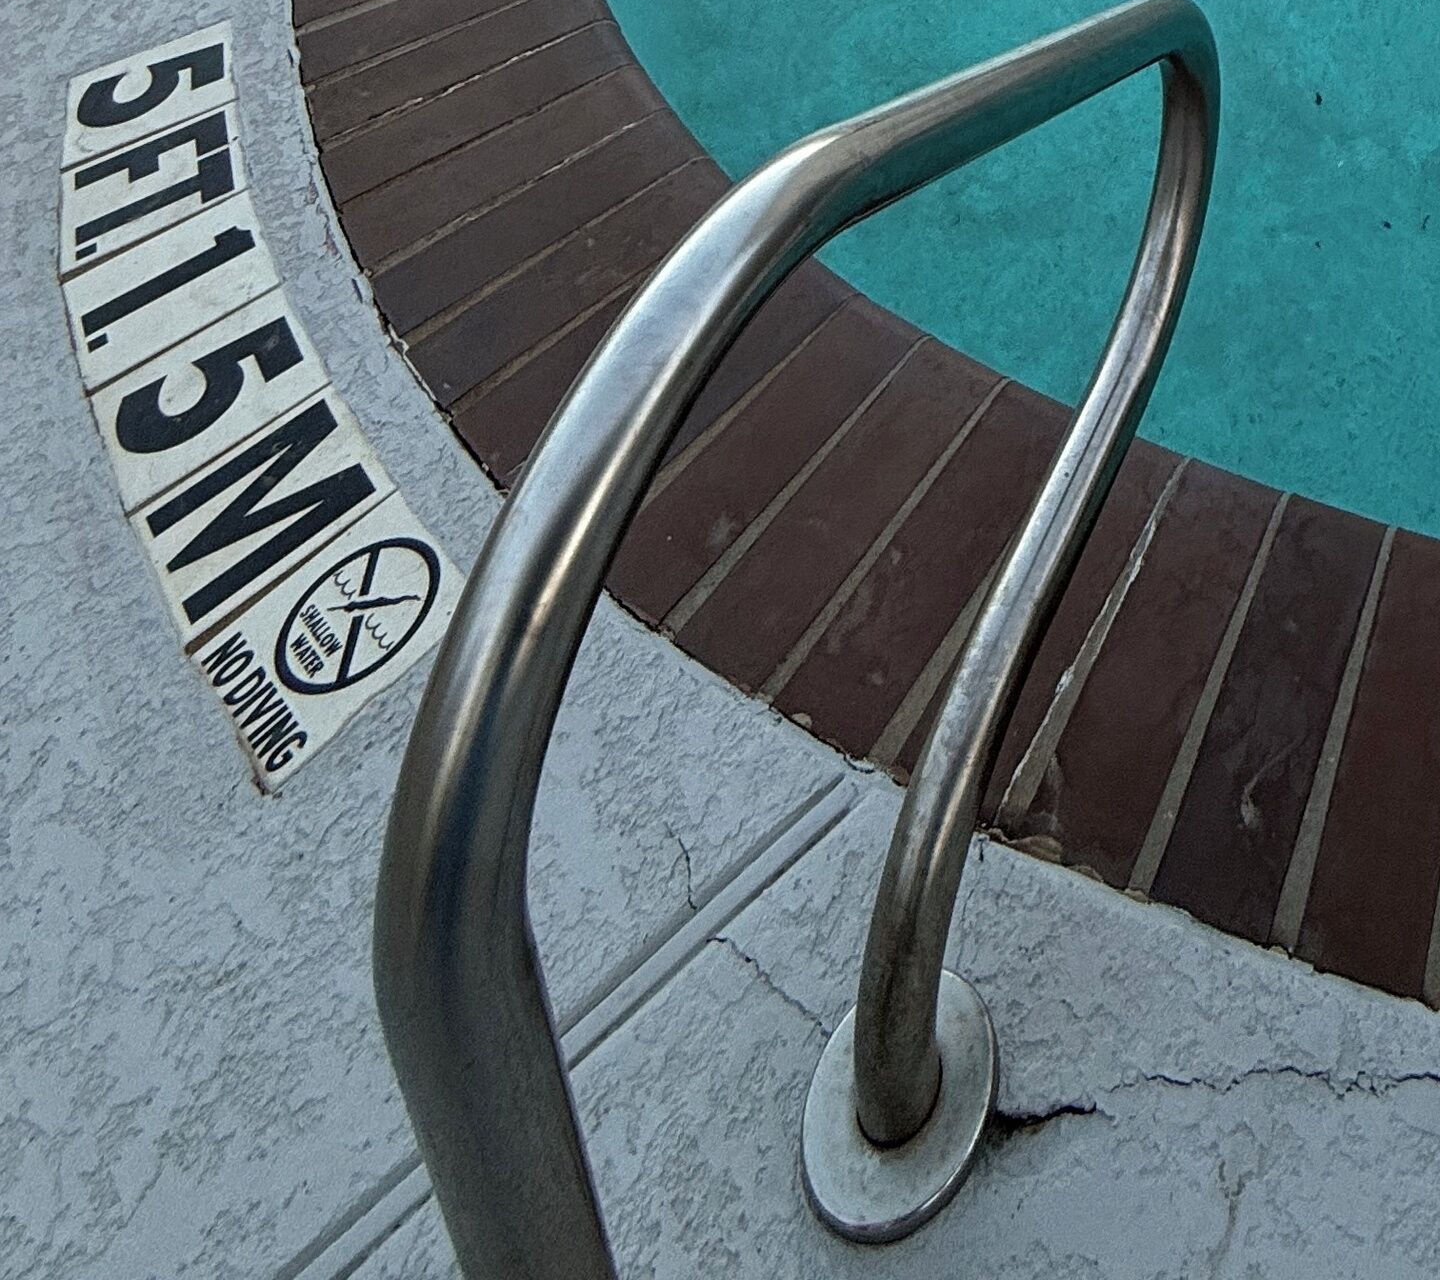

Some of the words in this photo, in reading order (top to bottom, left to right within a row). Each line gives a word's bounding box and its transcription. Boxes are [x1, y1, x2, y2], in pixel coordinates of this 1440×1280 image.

[288, 631, 324, 679] WATER
[298, 604, 343, 661] SHALLOW
[202, 630, 241, 681] NO
[223, 668, 308, 775] DIVING
